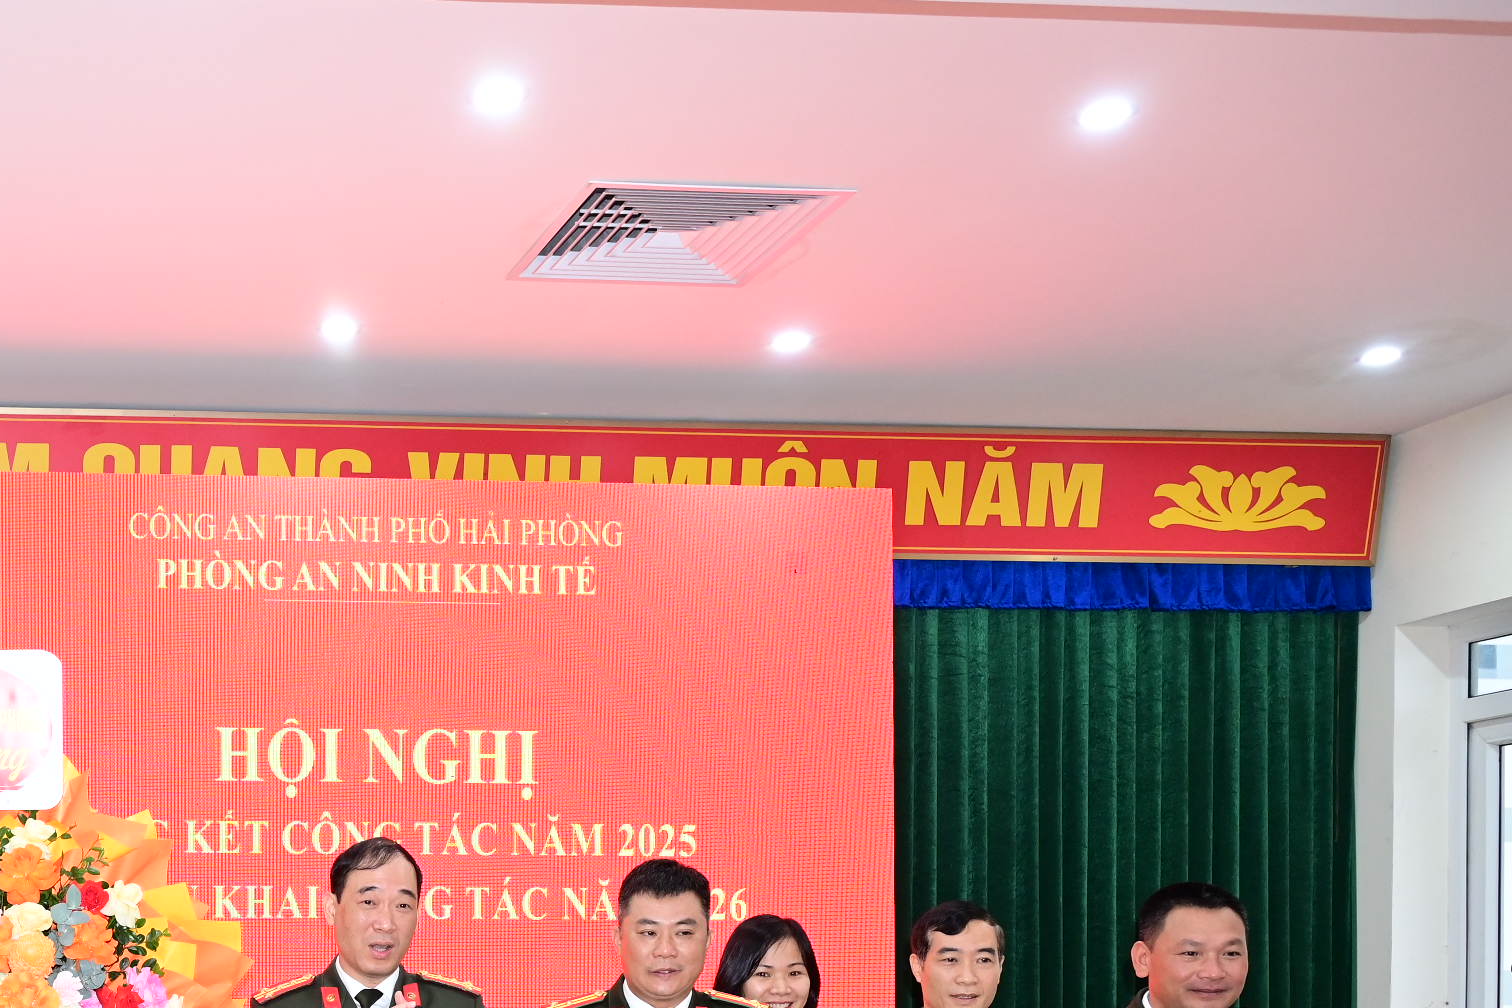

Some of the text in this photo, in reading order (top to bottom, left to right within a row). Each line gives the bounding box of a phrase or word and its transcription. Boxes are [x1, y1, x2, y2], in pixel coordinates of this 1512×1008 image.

[904, 445, 1104, 528] NĂM
[129, 505, 624, 547] CÔNG AN THÀNH PHỐ HẢI PHÒNG
[157, 550, 598, 596] PHÒNG AN NINH KINH TẾ
[215, 718, 539, 801] HỘI NGHỊ
[185, 810, 269, 854] KẾT
[413, 812, 498, 856] TÁC
[511, 813, 605, 857] NĂM
[618, 823, 698, 858] 2025
[213, 885, 320, 919] KHAI
[465, 876, 549, 921] TÁC
[562, 878, 617, 921] NĂ
[709, 887, 748, 922] 26
